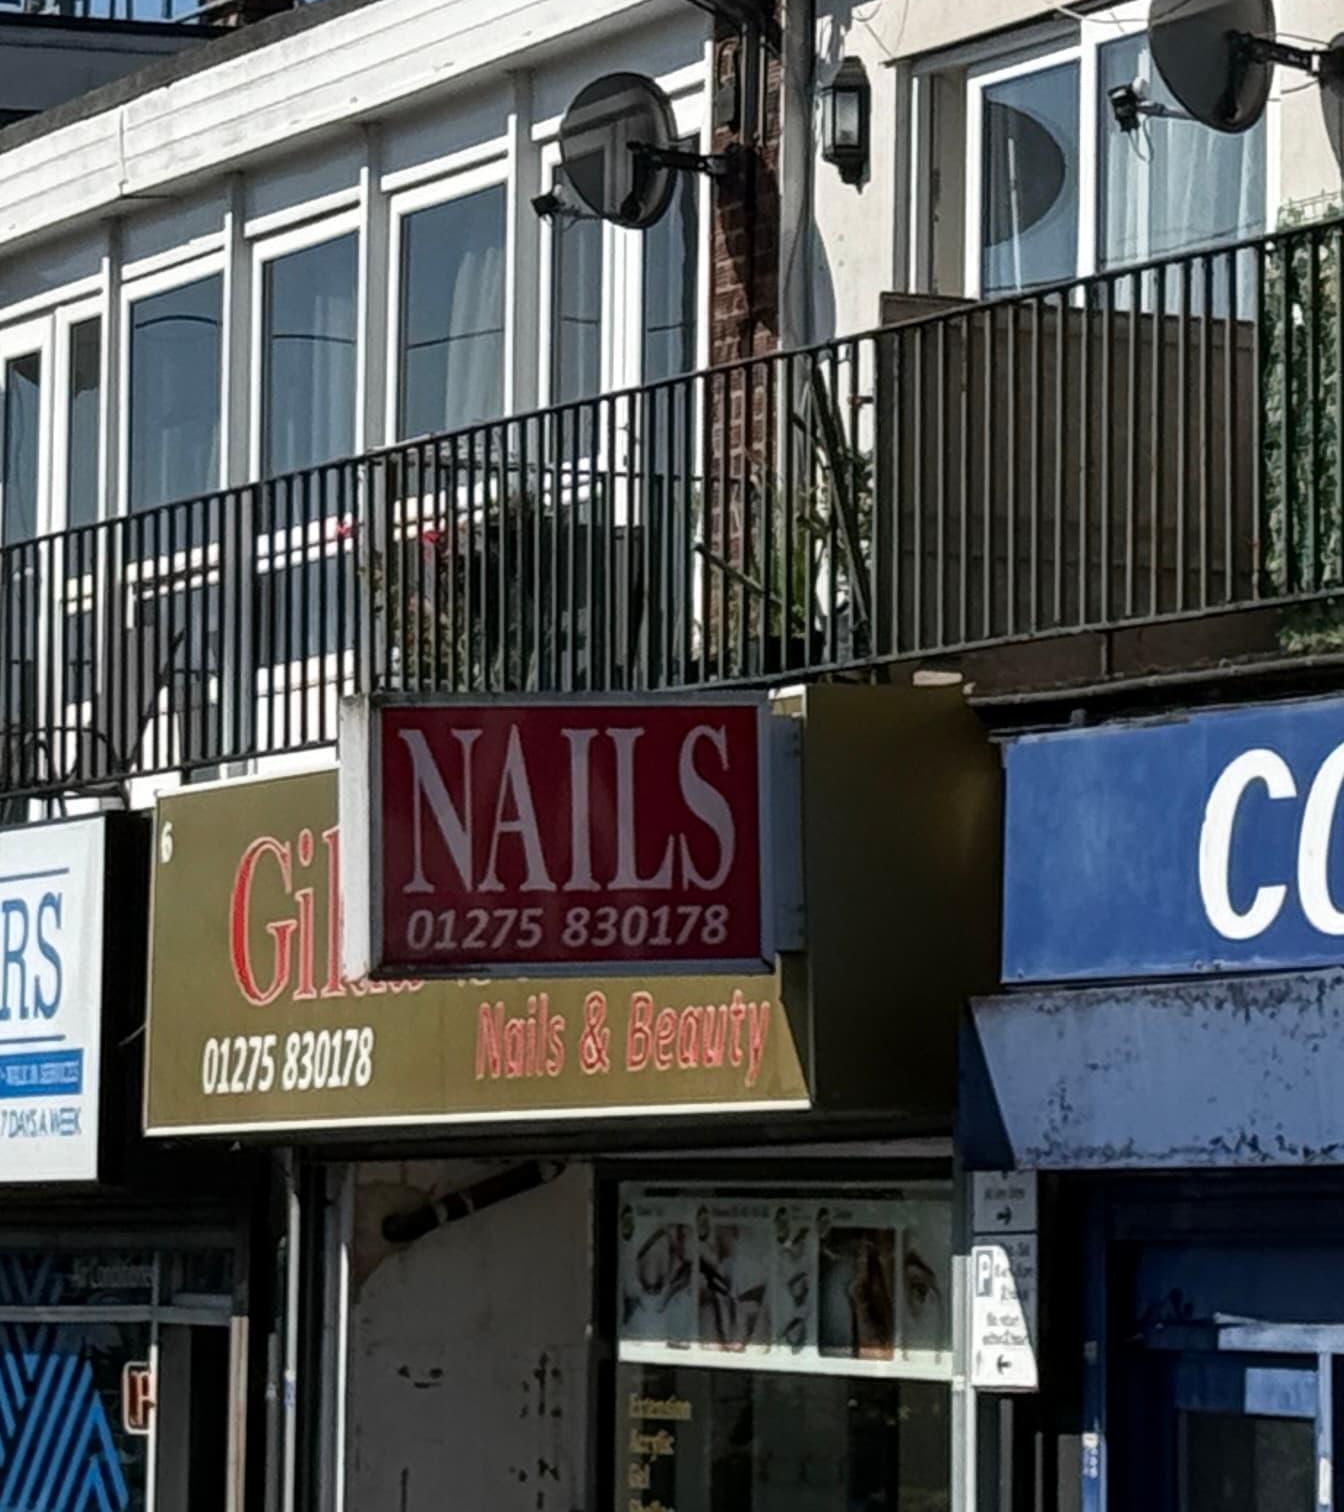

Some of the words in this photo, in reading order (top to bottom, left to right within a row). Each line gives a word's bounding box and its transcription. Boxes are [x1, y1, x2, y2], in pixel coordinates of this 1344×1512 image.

[398, 723, 736, 893] NAILS
[161, 822, 173, 864] 6
[406, 907, 544, 950] 01275
[562, 904, 729, 948] 830178
[203, 1034, 276, 1096] 01275
[282, 1027, 374, 1091] 830178
[476, 992, 565, 1080] Nails
[578, 990, 611, 1074] &
[627, 989, 770, 1087] Beauty
